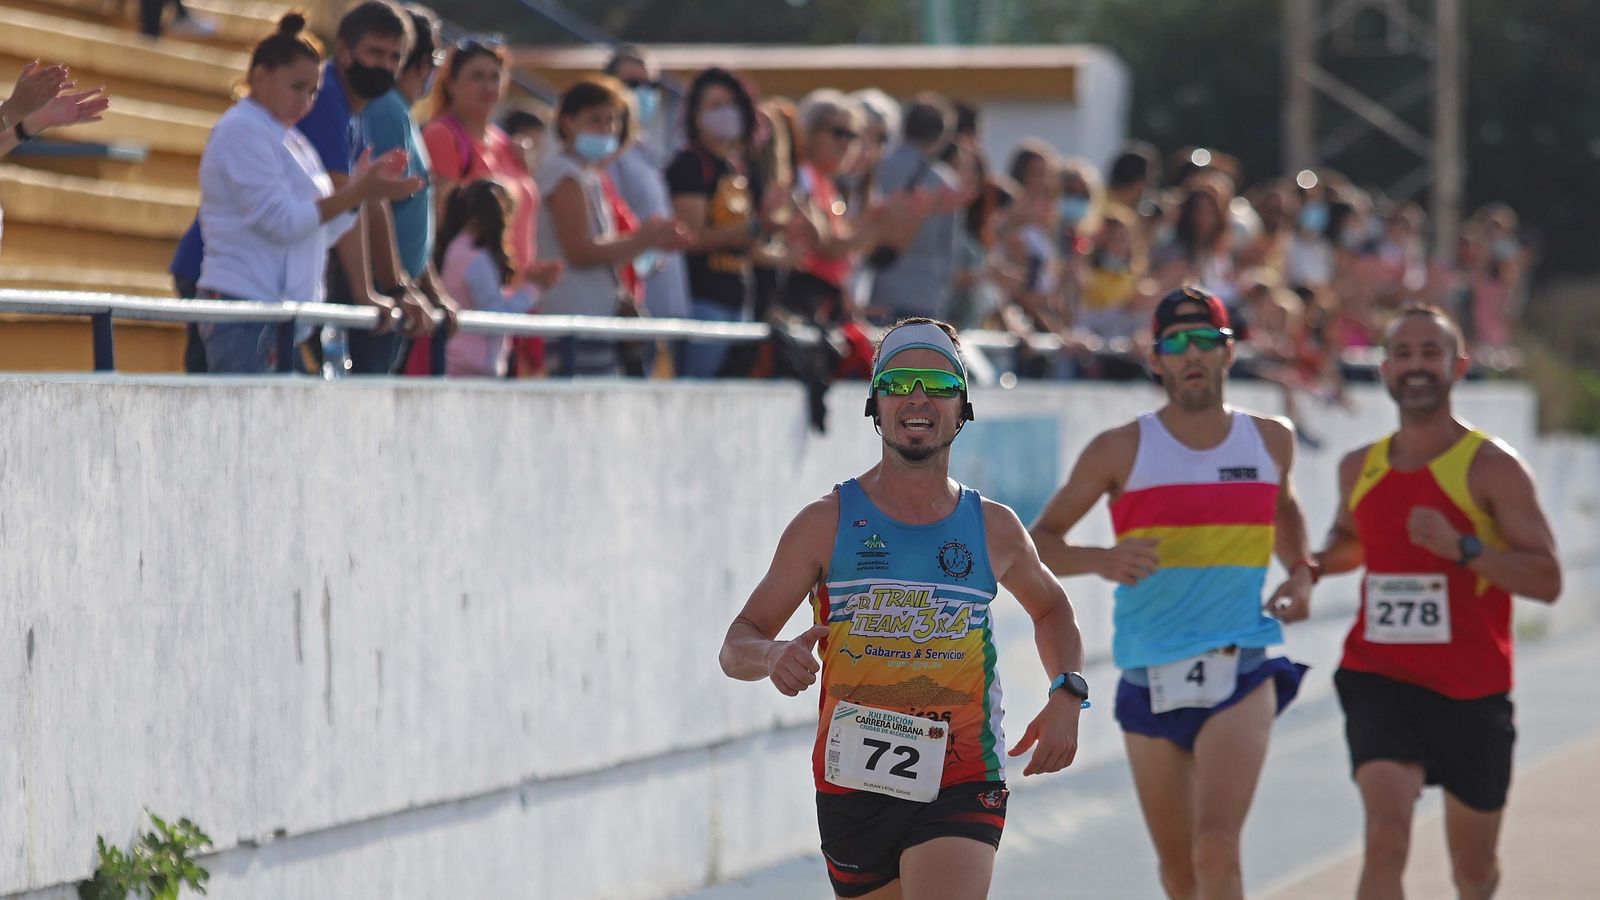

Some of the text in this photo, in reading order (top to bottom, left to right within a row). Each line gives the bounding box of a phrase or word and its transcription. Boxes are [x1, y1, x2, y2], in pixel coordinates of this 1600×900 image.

[872, 588, 931, 611] TRAIL
[854, 613, 914, 633] TEAM
[1377, 602, 1441, 626] 278
[864, 644, 965, 660] Gabarras & Servicios
[1186, 661, 1205, 687] 4
[855, 715, 924, 736] CARRERA URBANA
[868, 711, 882, 719] XXI
[860, 725, 880, 733] CIUDAD
[889, 730, 917, 741] ALGECIRAS
[863, 737, 920, 780] 72
